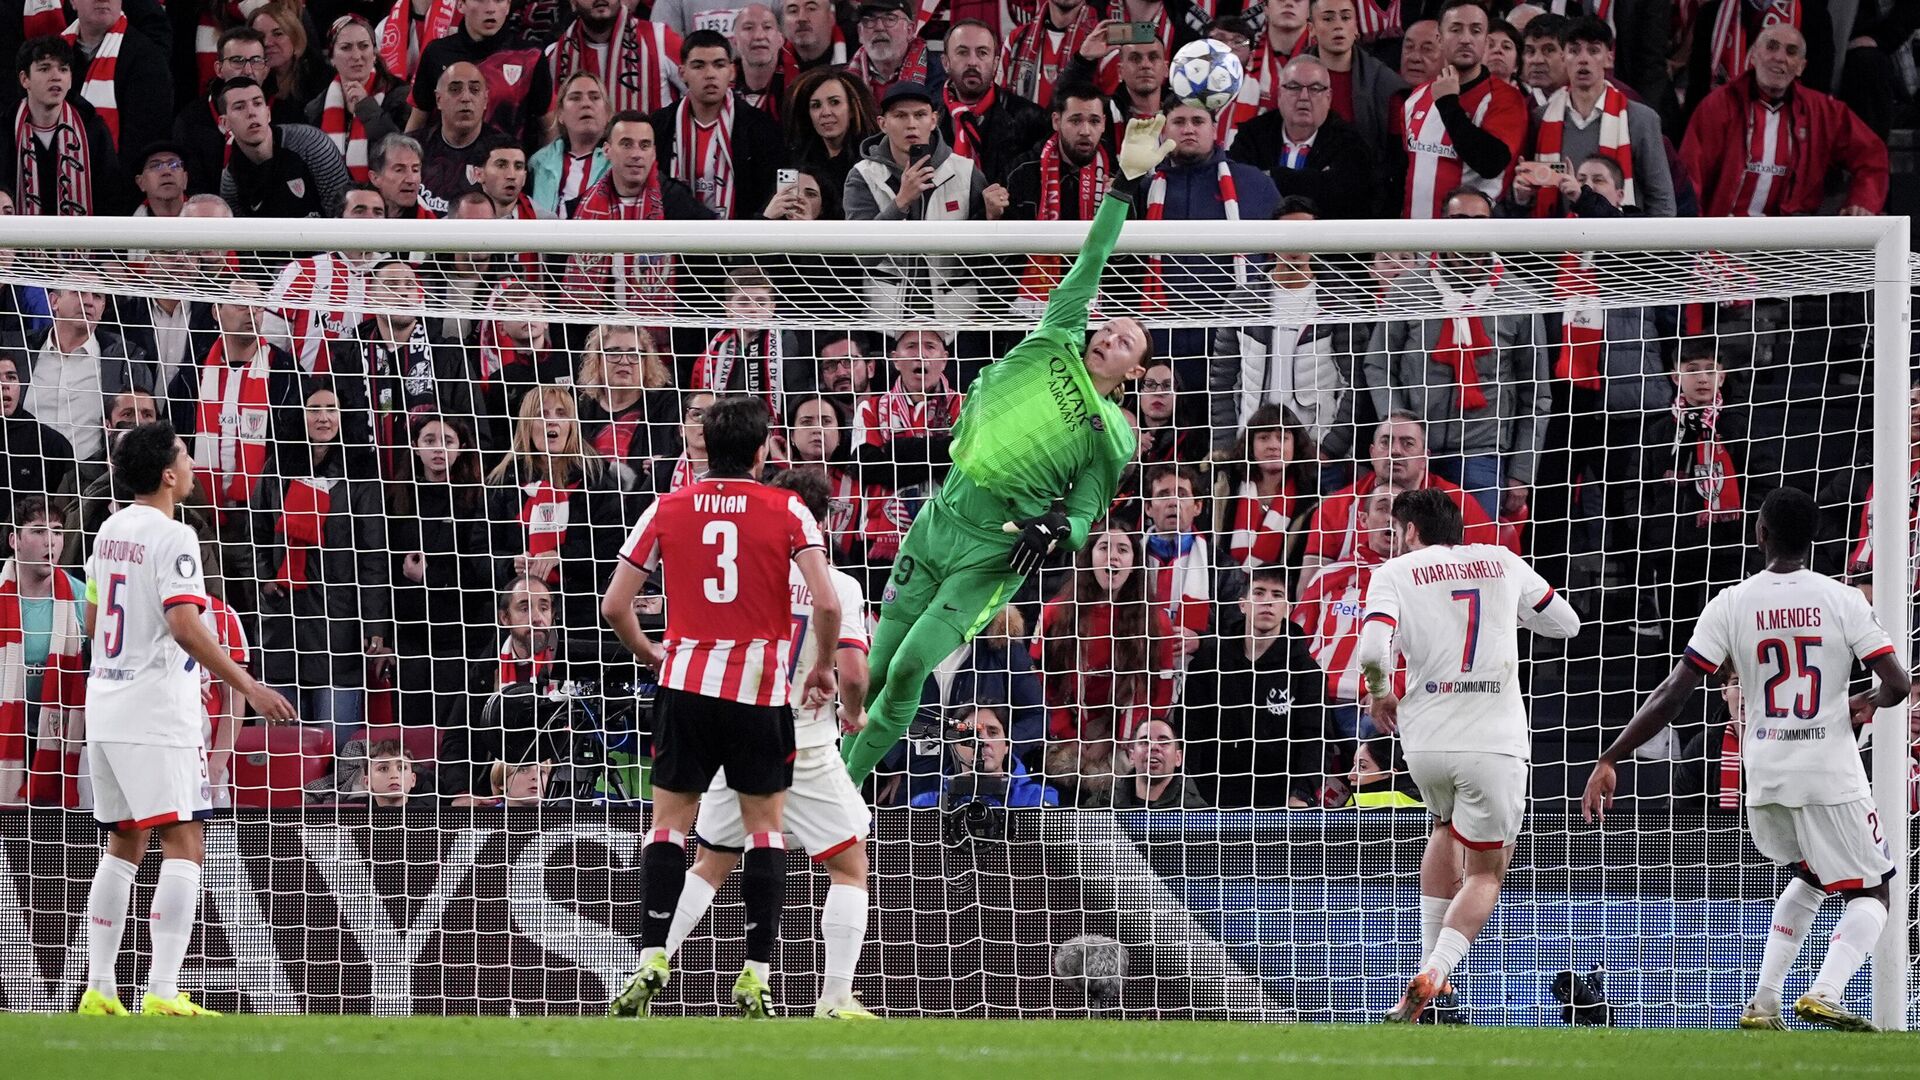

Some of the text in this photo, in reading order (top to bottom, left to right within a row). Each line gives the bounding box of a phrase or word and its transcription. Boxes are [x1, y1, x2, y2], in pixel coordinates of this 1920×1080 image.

[314, 310, 354, 335] Kutxa
[1048, 380, 1078, 432] AIRWAYS
[1049, 357, 1089, 427] QATAR
[693, 494, 747, 513] VIVIAN
[702, 520, 739, 604] 3
[1411, 559, 1505, 586] KVARATSKHELIA
[790, 584, 813, 606] EVE
[104, 573, 127, 659] 5
[1451, 588, 1481, 673] 7
[1756, 607, 1821, 631] N.MENDES
[1438, 680, 1501, 695] FOR COMMUNITIES
[1757, 636, 1823, 720] 25
[1777, 727, 1826, 741] COMMUNITIES
[1867, 811, 1883, 845] 2
